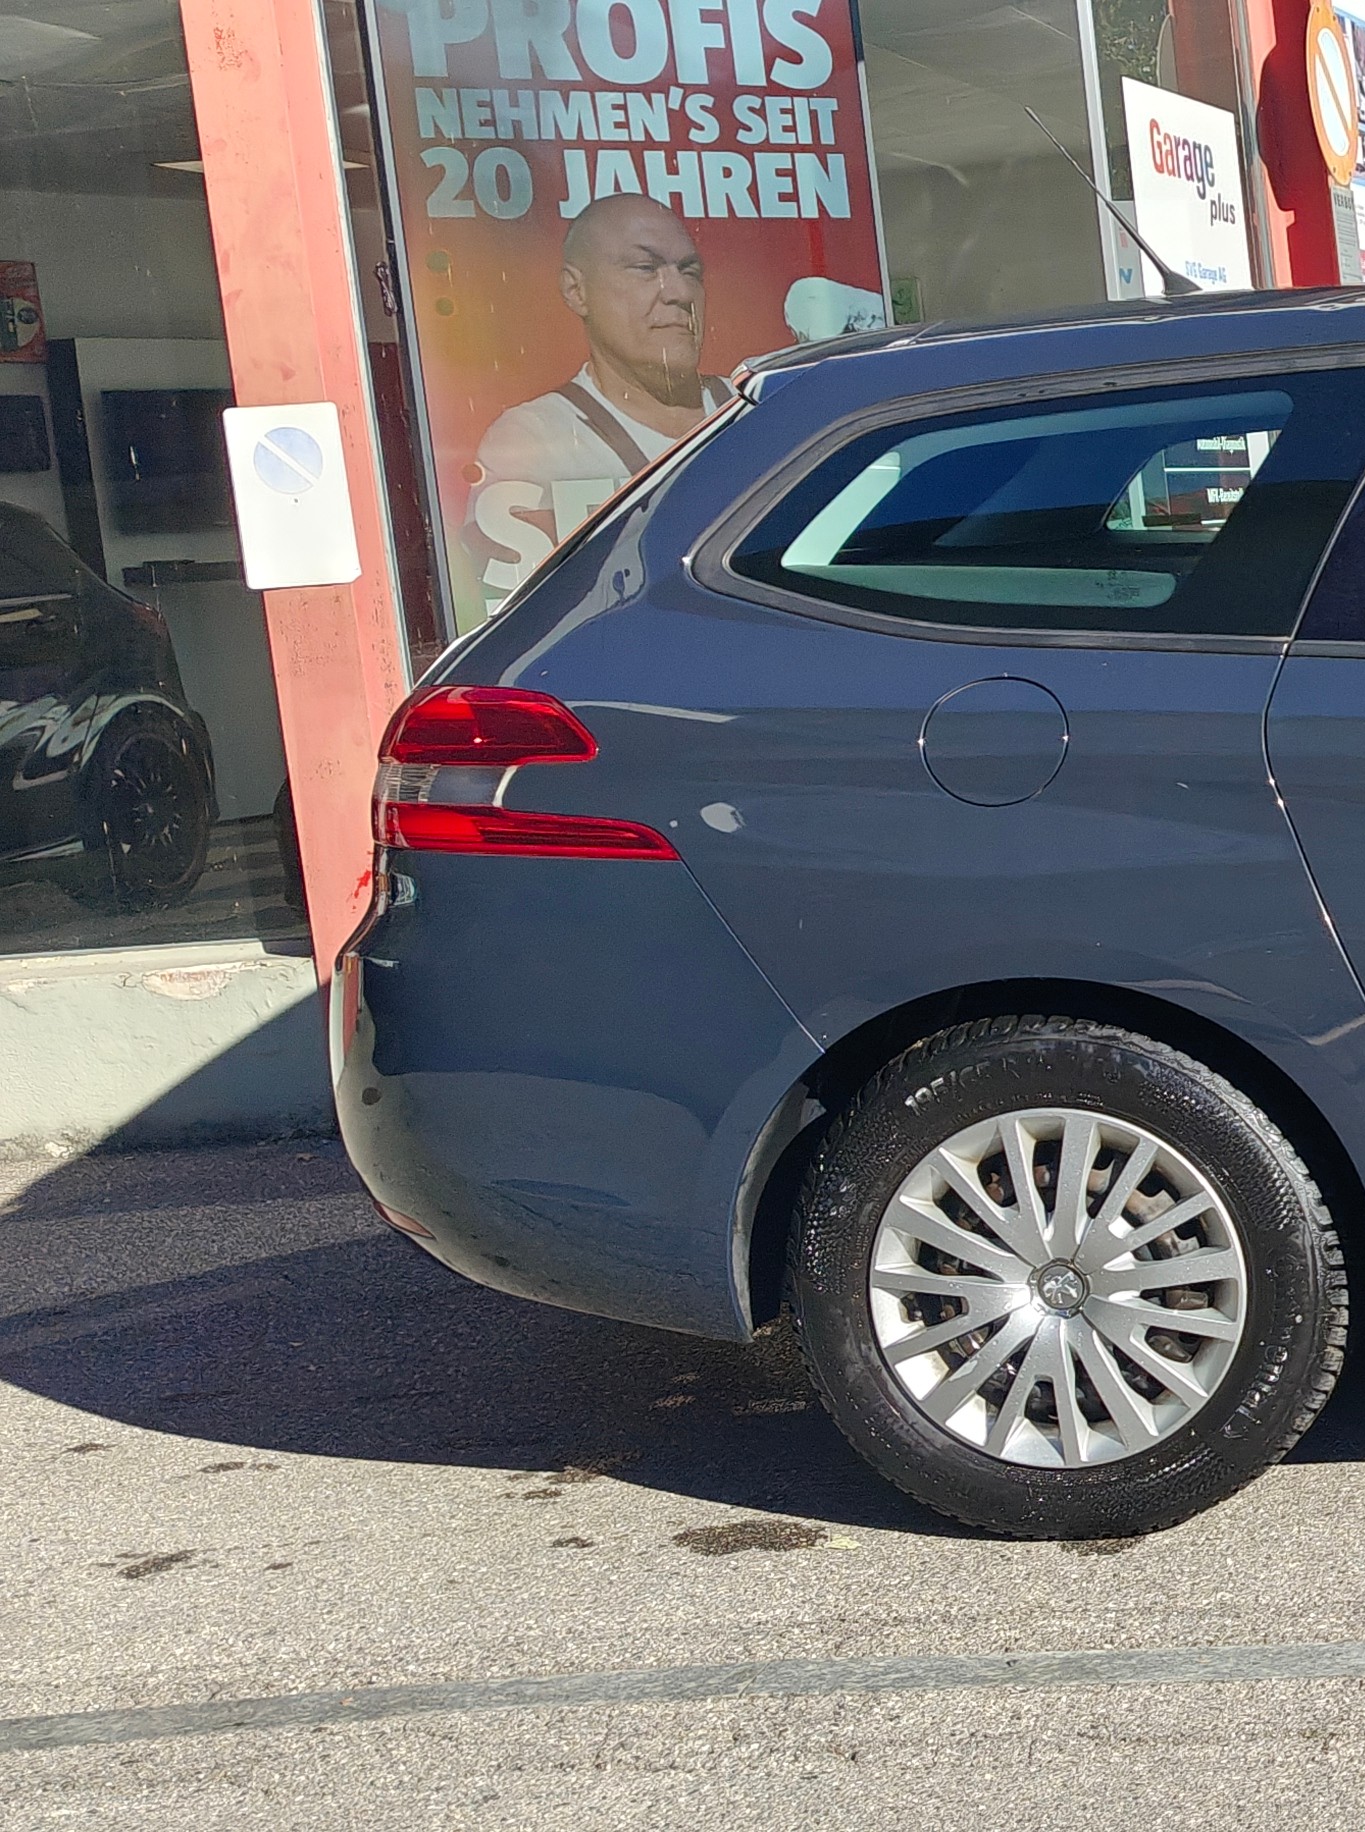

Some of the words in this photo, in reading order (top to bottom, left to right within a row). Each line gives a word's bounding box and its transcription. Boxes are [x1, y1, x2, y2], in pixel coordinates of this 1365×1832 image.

[407, 0, 833, 89] PROFIS
[415, 86, 720, 144] NEHMEN'S
[733, 94, 838, 145] SEIT
[419, 146, 533, 219] 20
[560, 149, 851, 219] JAHREN
[1149, 118, 1215, 200] Garage
[1210, 193, 1236, 226] plus
